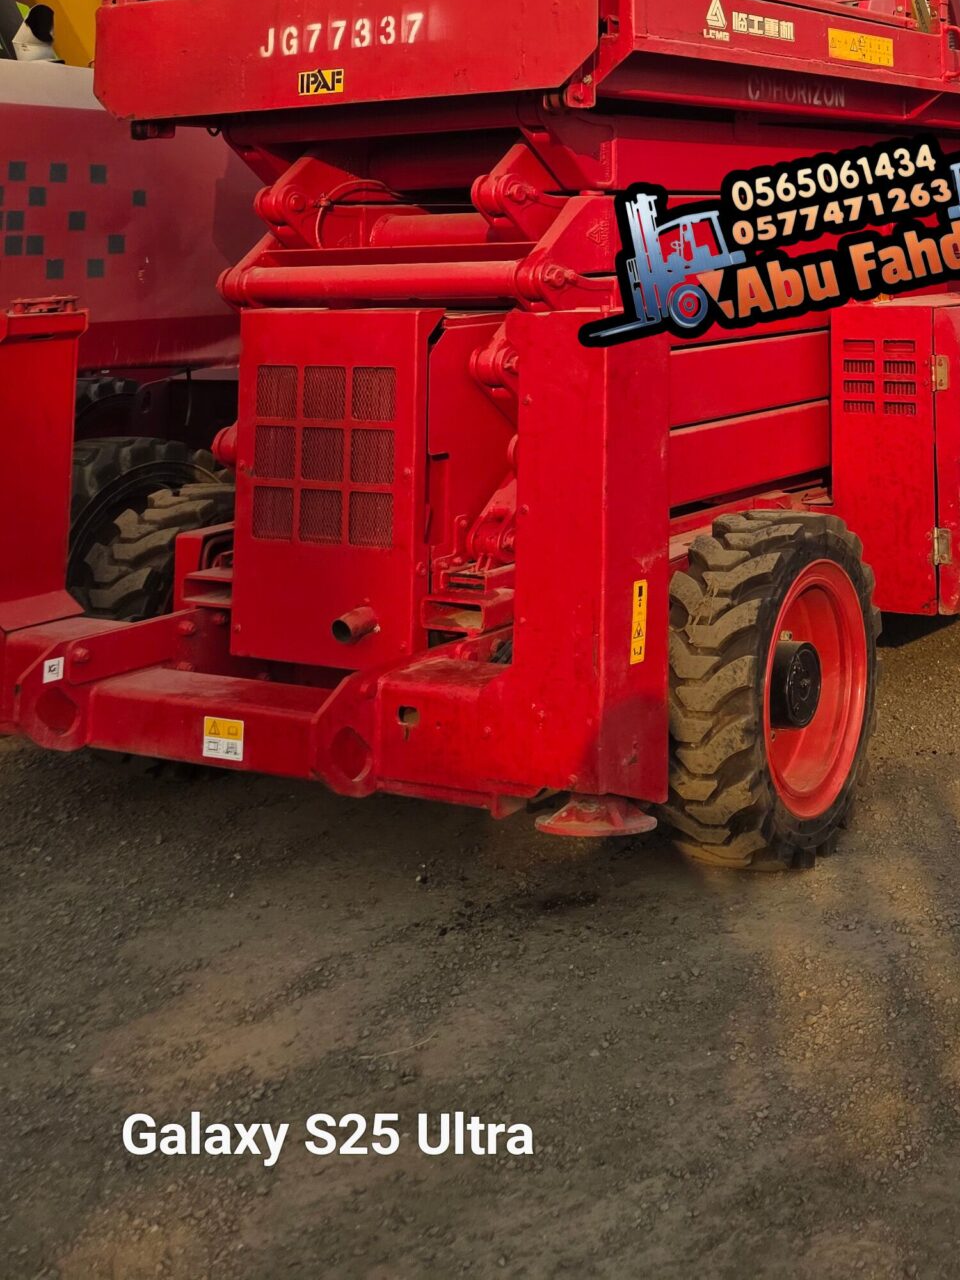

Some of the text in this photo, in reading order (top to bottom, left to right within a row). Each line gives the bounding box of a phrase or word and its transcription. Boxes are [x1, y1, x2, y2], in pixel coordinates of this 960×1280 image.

[259, 12, 425, 58] JG77337
[732, 11, 795, 42] 临工重机
[300, 69, 343, 93] IPAF
